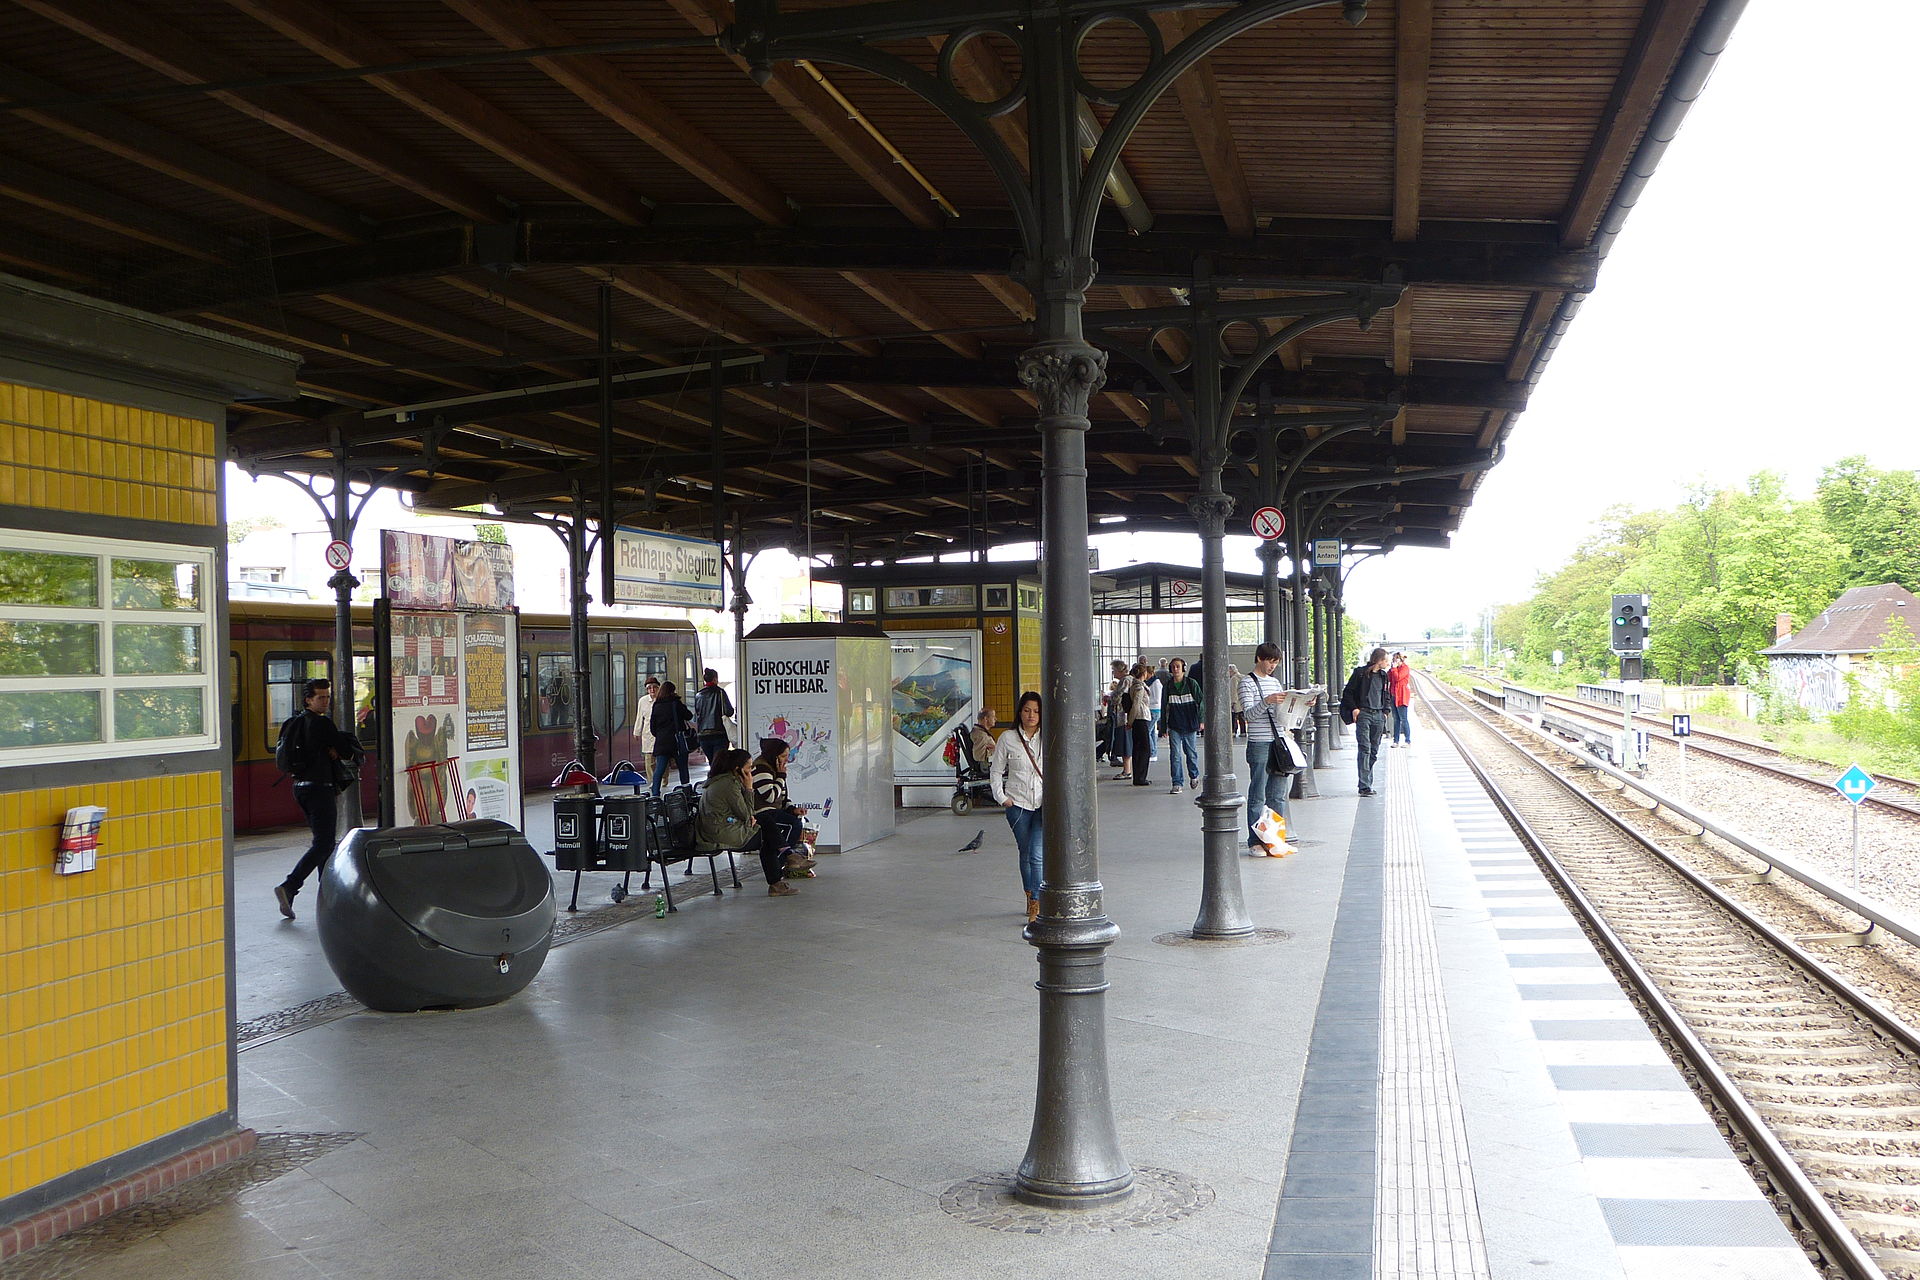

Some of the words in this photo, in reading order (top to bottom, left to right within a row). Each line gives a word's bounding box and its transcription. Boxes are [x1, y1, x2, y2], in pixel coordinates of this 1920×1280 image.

[620, 539, 673, 572] Rathaus
[675, 546, 717, 582] Steglitz
[752, 658, 830, 676] BÜROSCHLAF
[754, 679, 772, 694] IST
[774, 678, 828, 694] HEILBAR.
[1674, 716, 1689, 734] H
[609, 842, 628, 850] Papier
